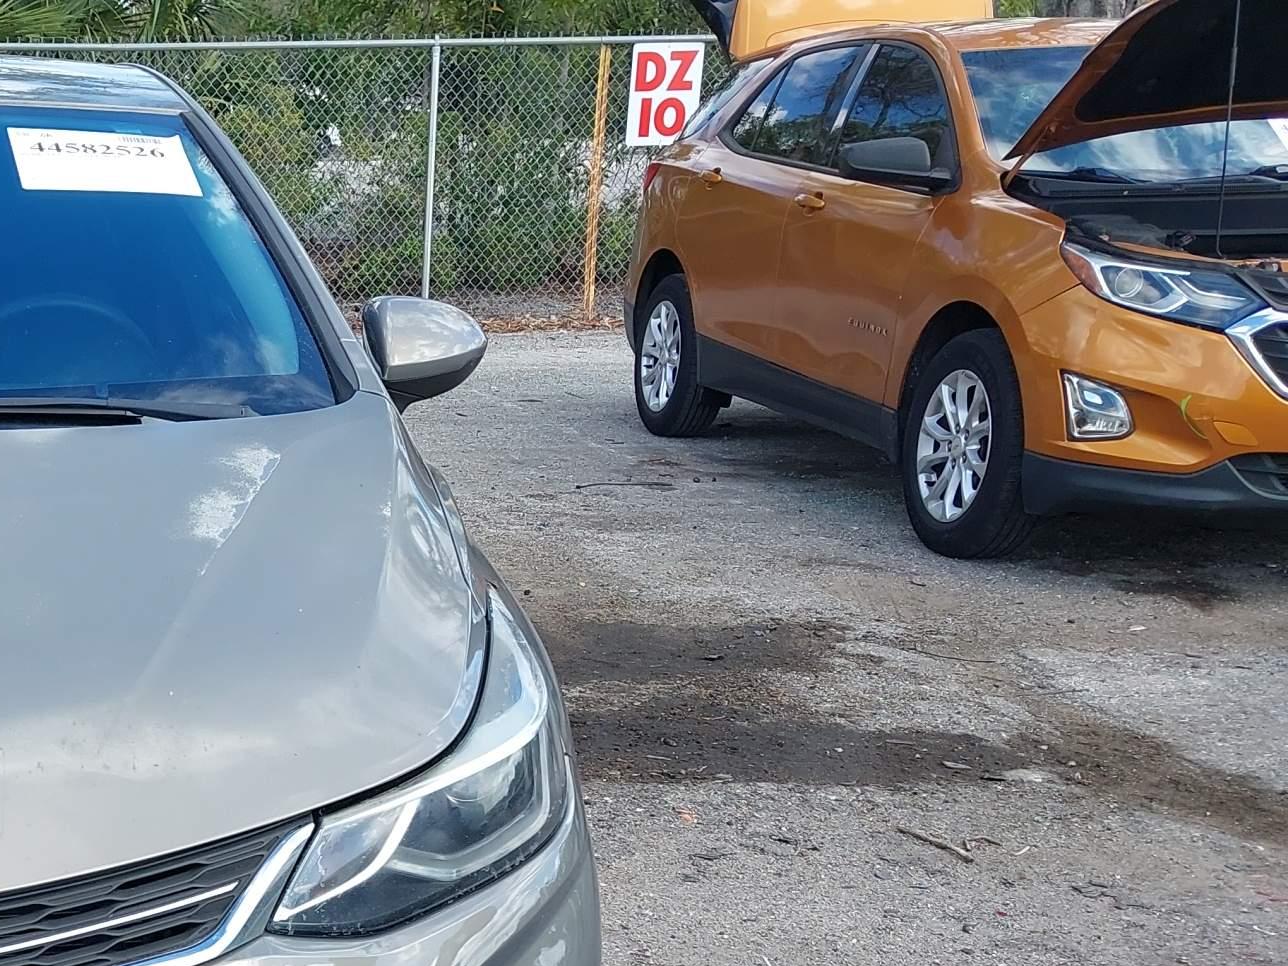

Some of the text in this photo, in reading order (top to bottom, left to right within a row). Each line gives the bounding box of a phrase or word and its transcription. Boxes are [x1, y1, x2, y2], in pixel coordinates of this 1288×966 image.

[634, 49, 700, 92] DZ
[637, 97, 686, 138] 10
[29, 141, 166, 159] 44582526
